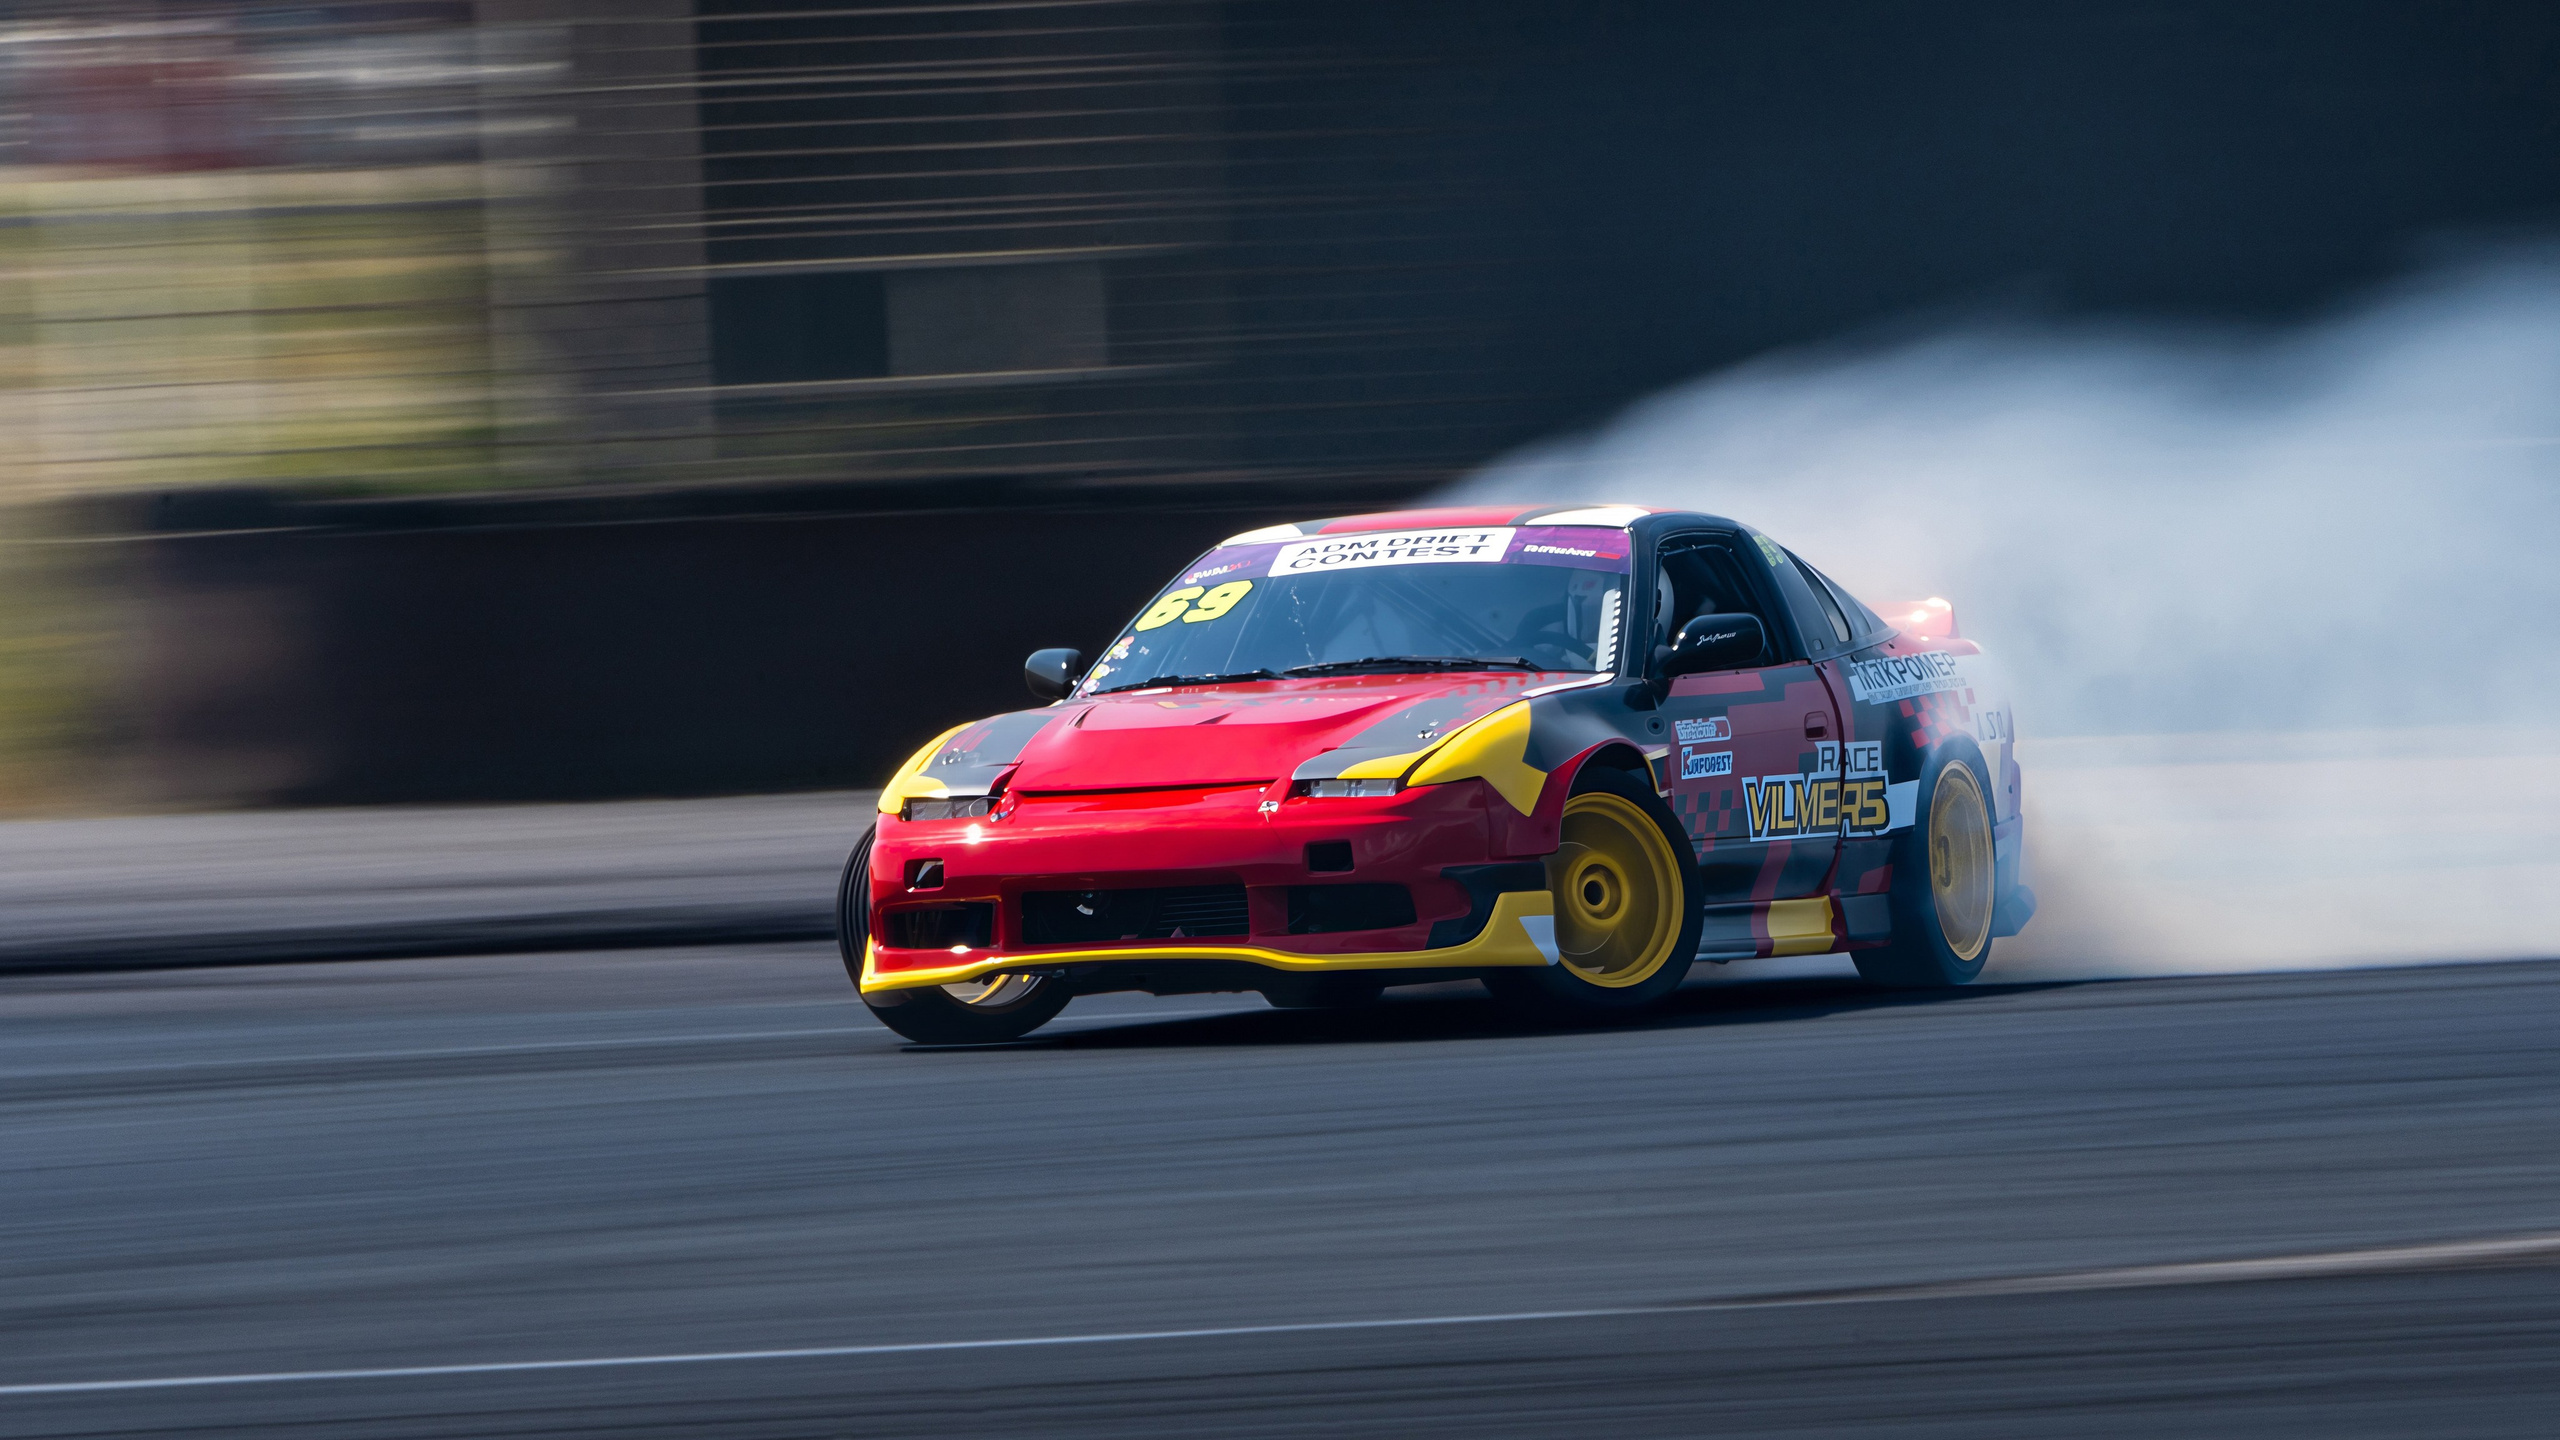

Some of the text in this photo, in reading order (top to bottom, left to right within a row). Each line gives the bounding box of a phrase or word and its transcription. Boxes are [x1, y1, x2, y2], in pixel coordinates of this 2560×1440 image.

[1288, 544, 1492, 569] CONTEST
[1297, 533, 1496, 557] ADM DRIFT
[1134, 579, 1254, 632] 69
[1821, 746, 1879, 772] RACE
[1748, 780, 1887, 831] VILMERS
